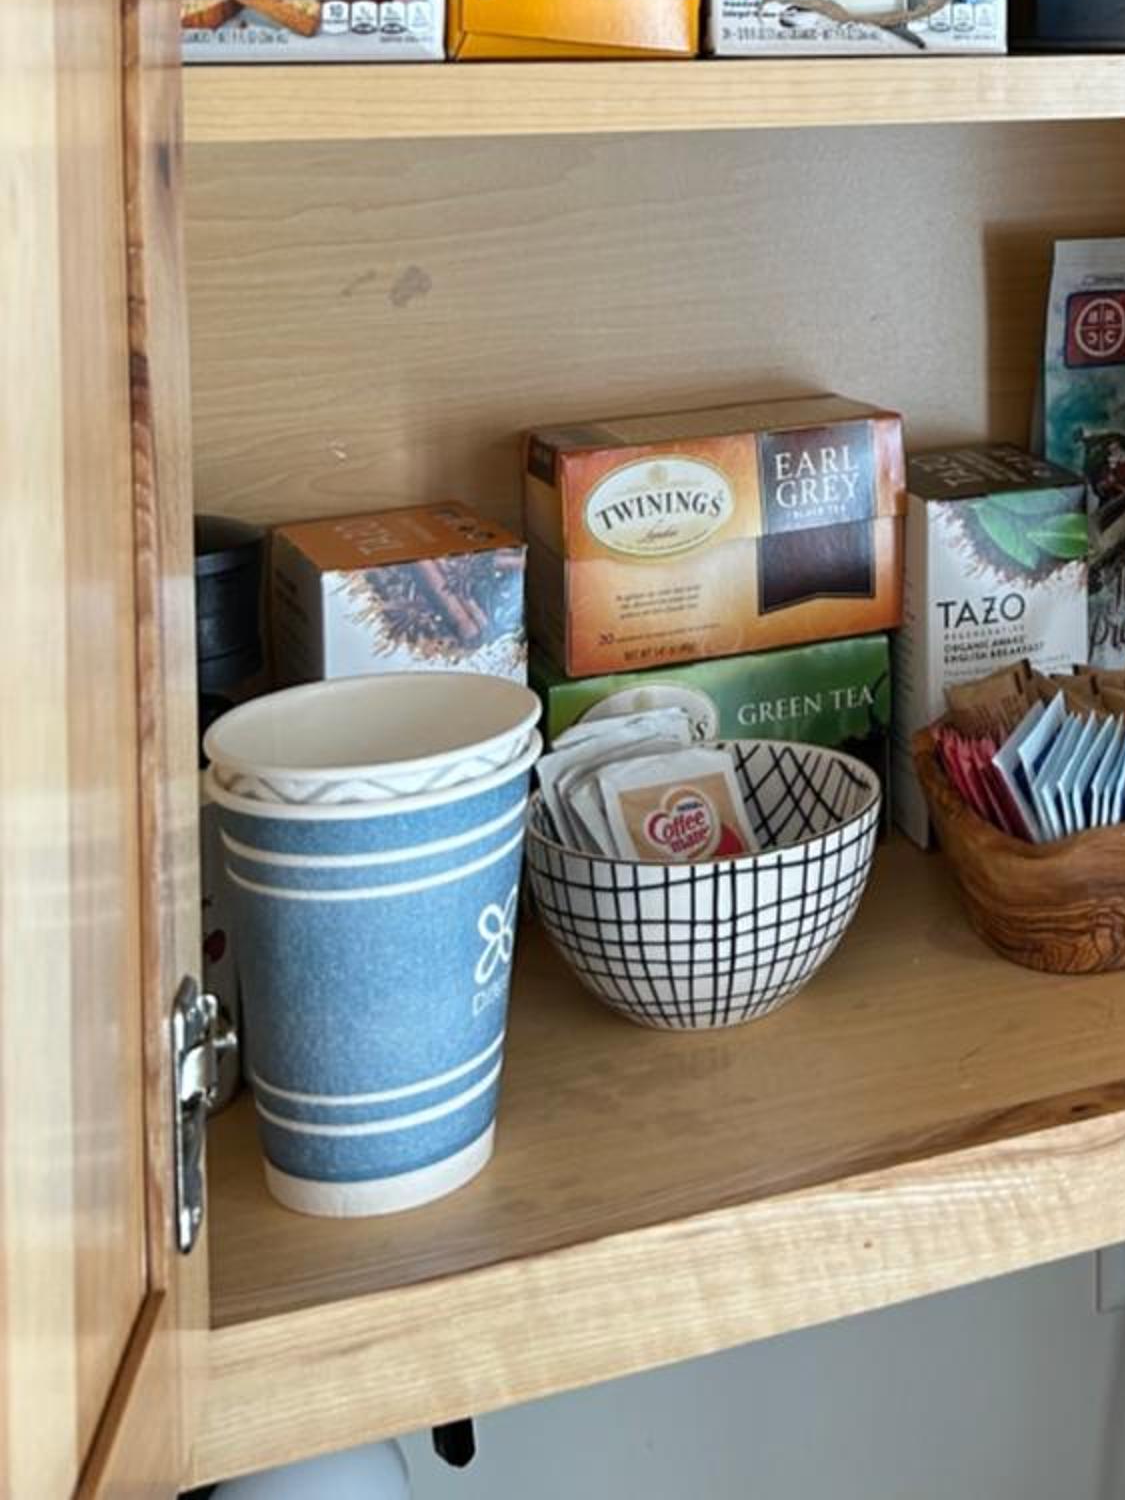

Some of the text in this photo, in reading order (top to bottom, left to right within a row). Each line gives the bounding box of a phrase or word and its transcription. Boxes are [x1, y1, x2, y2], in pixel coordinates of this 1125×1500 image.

[774, 445, 860, 481] EARL
[775, 473, 861, 509] GREY
[595, 490, 724, 530] TWININGS
[936, 592, 1025, 629] TAZO
[943, 641, 1045, 664] ENGLISH BREAKFAST
[737, 684, 876, 727] GREEN TEA
[647, 810, 706, 845] Coffee
[670, 825, 711, 854] mate
